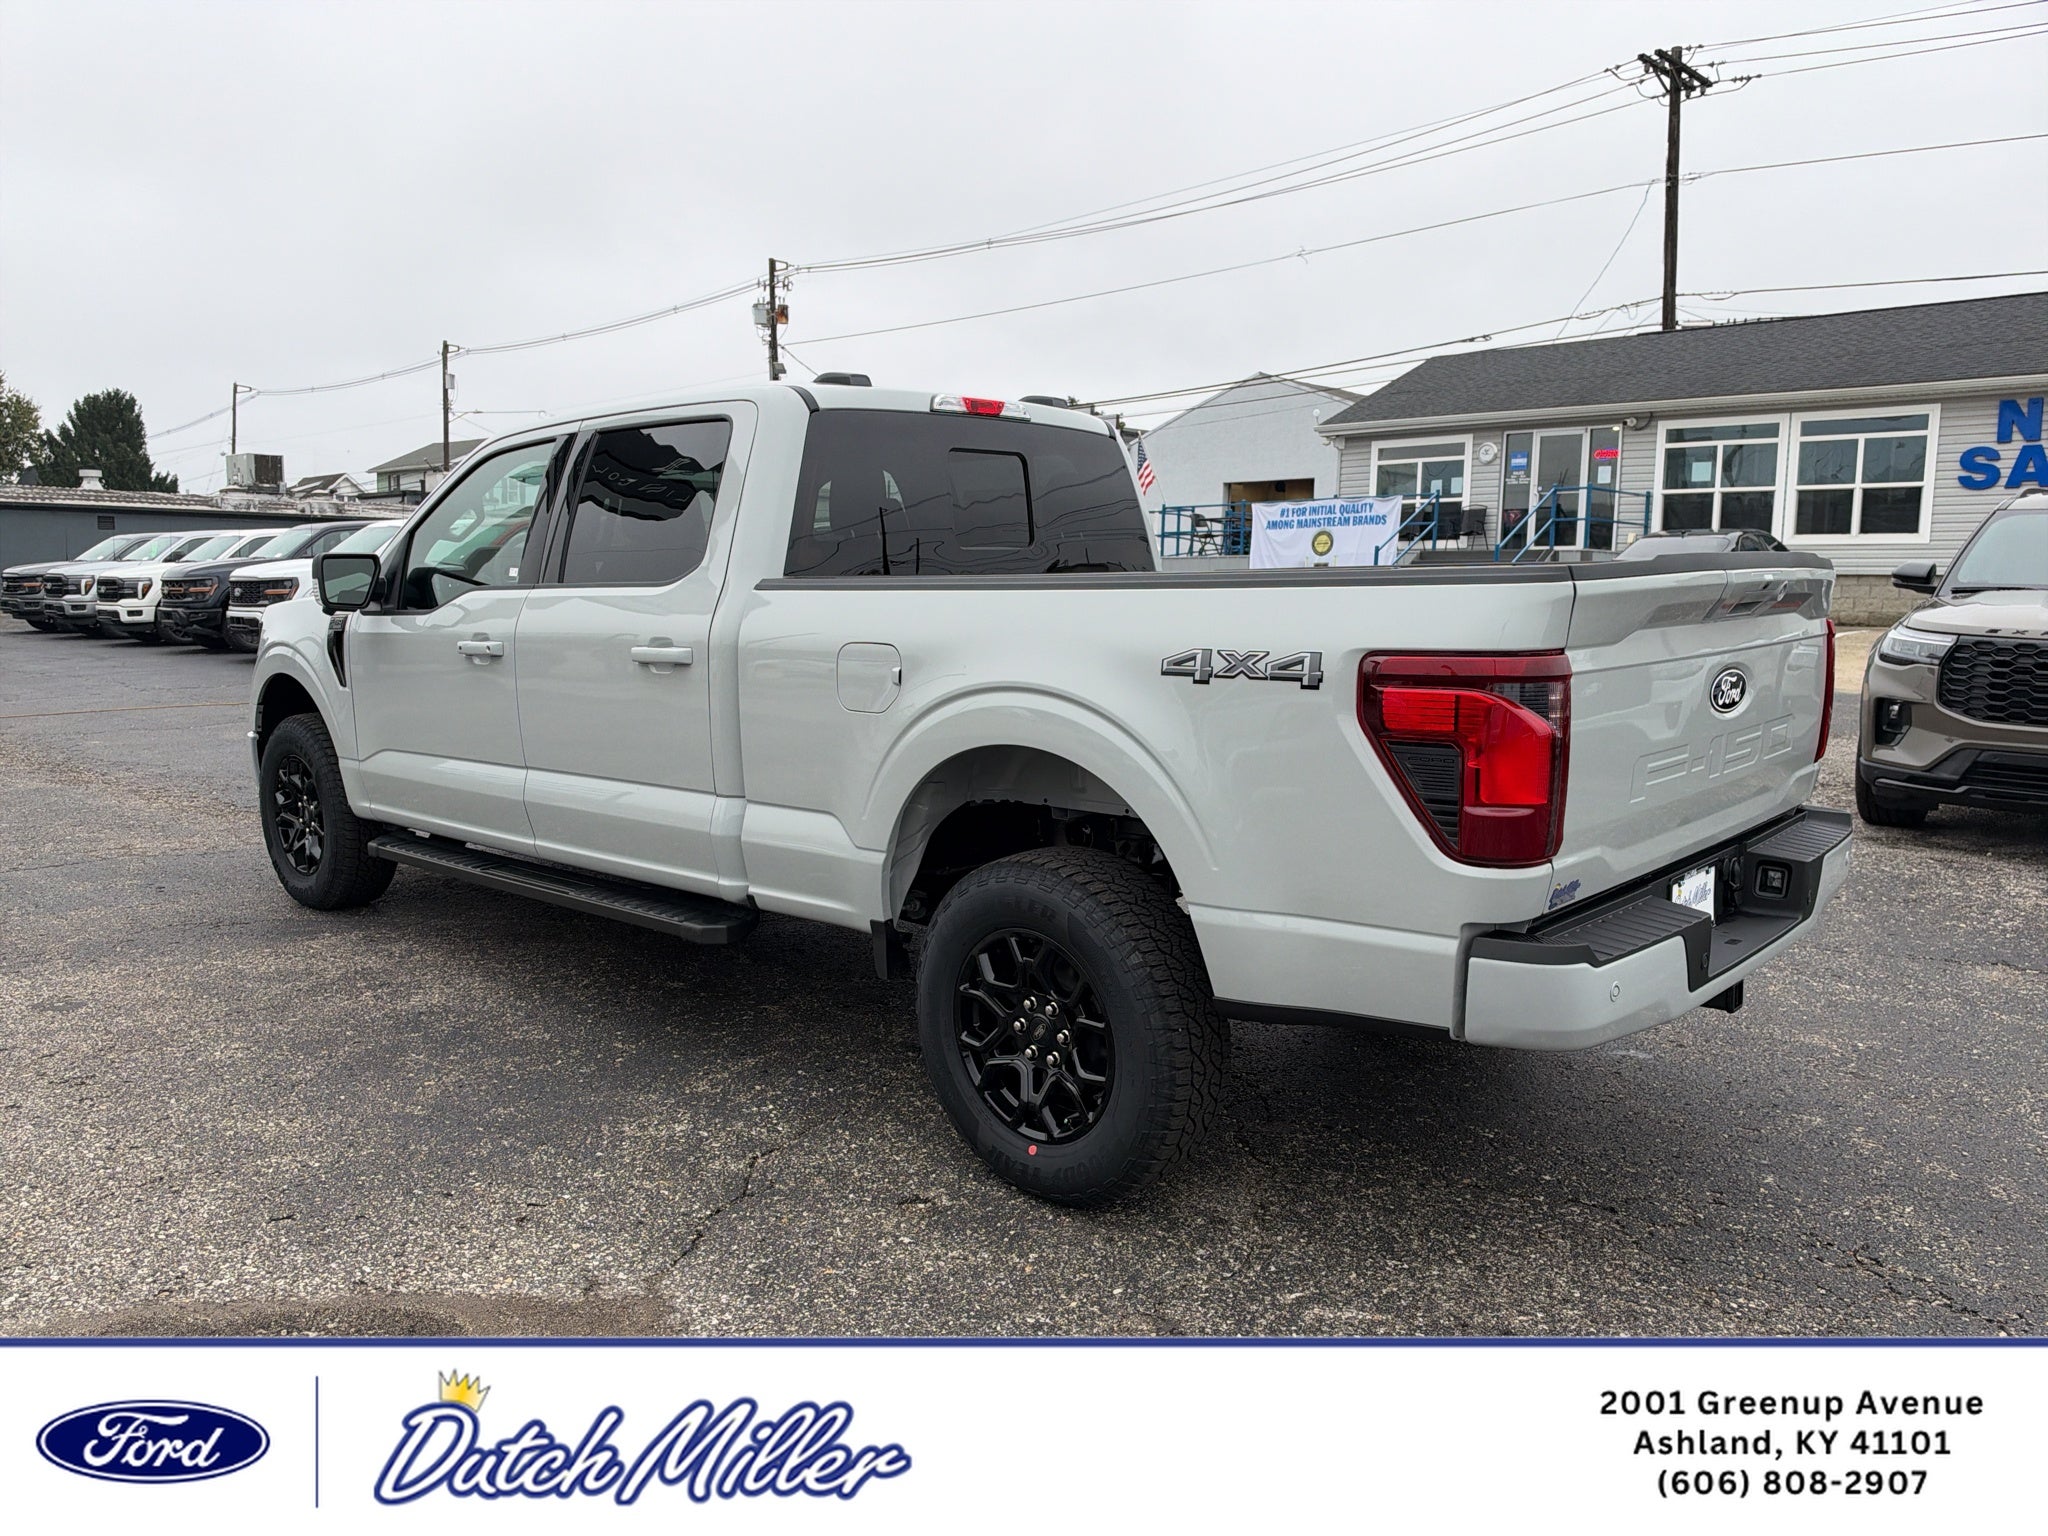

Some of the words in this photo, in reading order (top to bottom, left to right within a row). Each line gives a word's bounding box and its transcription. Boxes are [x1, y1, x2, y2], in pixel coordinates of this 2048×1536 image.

[1958, 444, 2048, 490] SA
[1265, 519, 1295, 530] AMONG
[1296, 516, 1351, 528] MAINSTREAM
[1352, 514, 1387, 526] BRANDS
[1280, 507, 1290, 518] #1
[1291, 506, 1307, 517] FOR
[1308, 504, 1337, 516] INITIAL
[1339, 502, 1374, 516] QUALITY
[1161, 648, 1324, 691] 4X4
[1717, 675, 1743, 707] Ford
[1629, 713, 1796, 803] F-150
